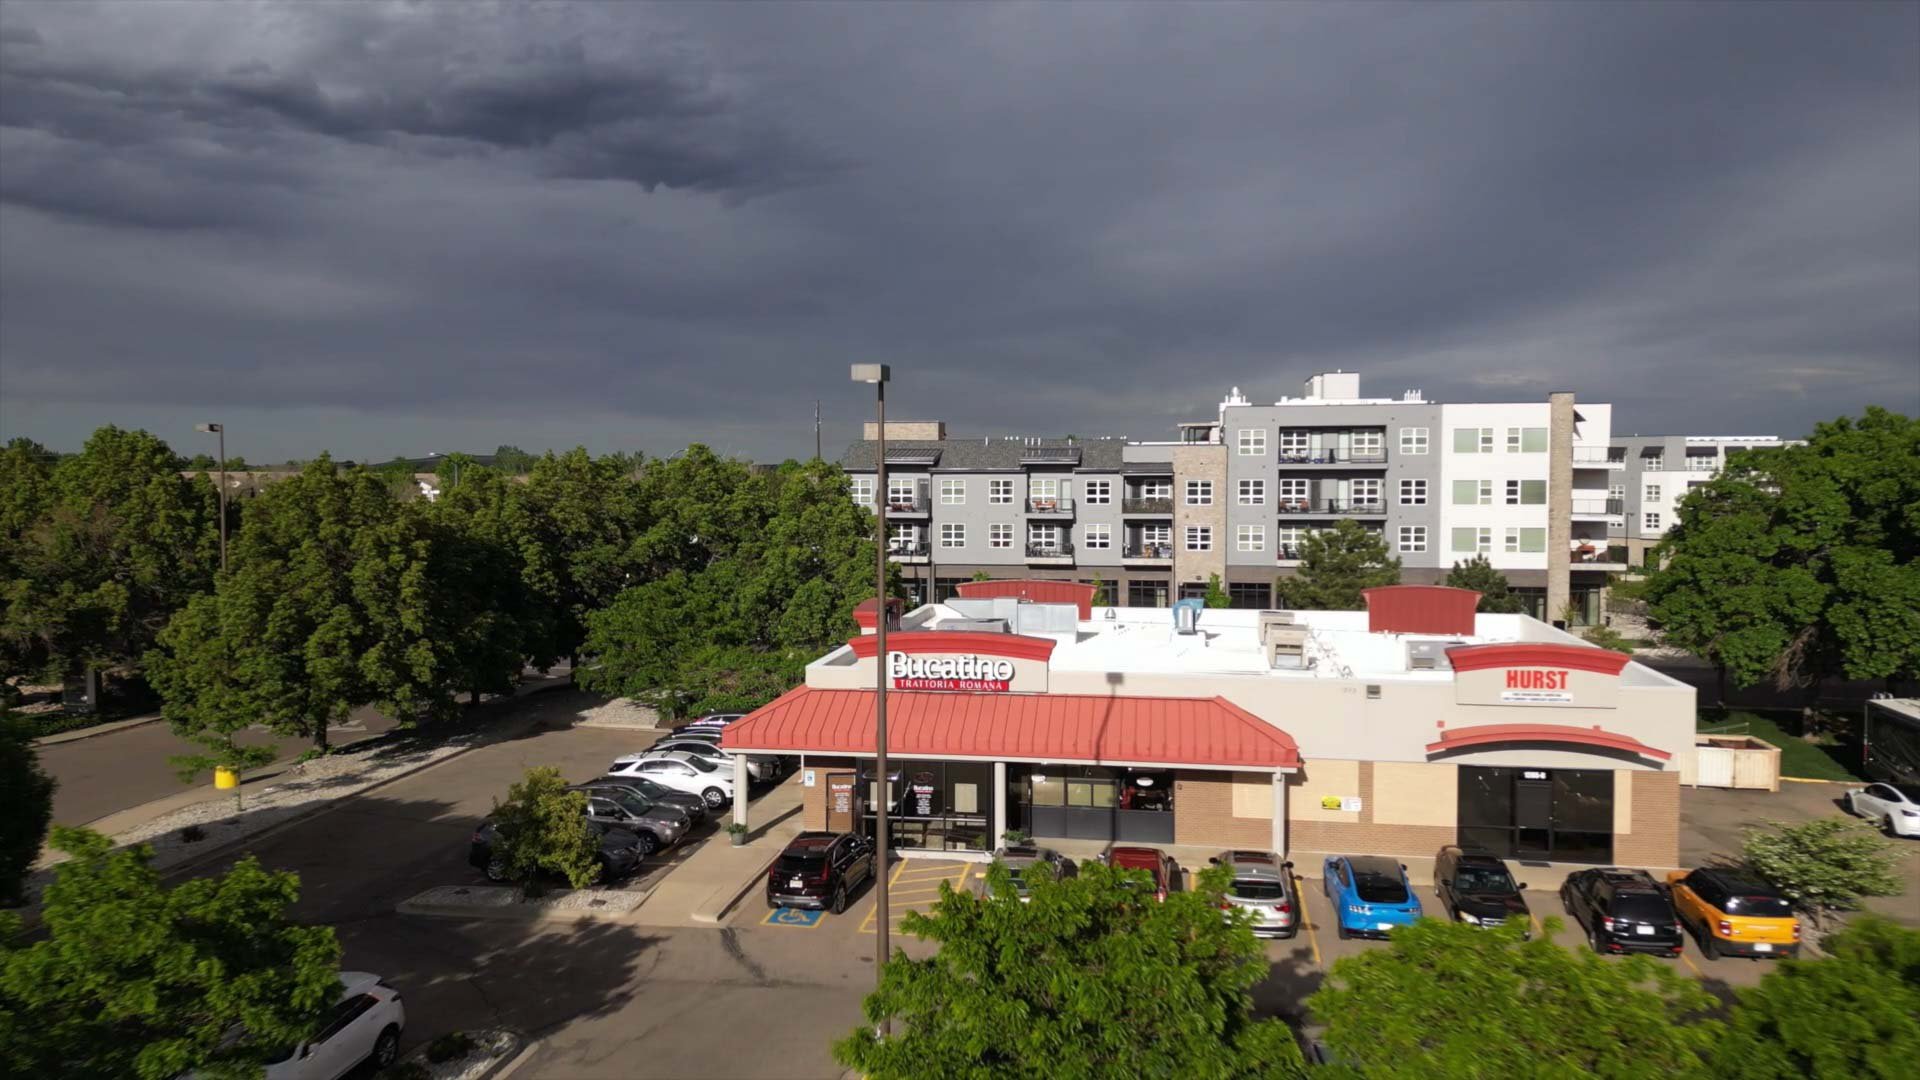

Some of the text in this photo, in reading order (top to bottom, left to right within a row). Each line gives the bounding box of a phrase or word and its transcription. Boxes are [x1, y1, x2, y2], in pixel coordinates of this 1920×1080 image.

[888, 651, 1014, 680] Bucatino
[900, 679, 1003, 690] TRATTORIA ROMANA
[1506, 670, 1569, 690] HURST
